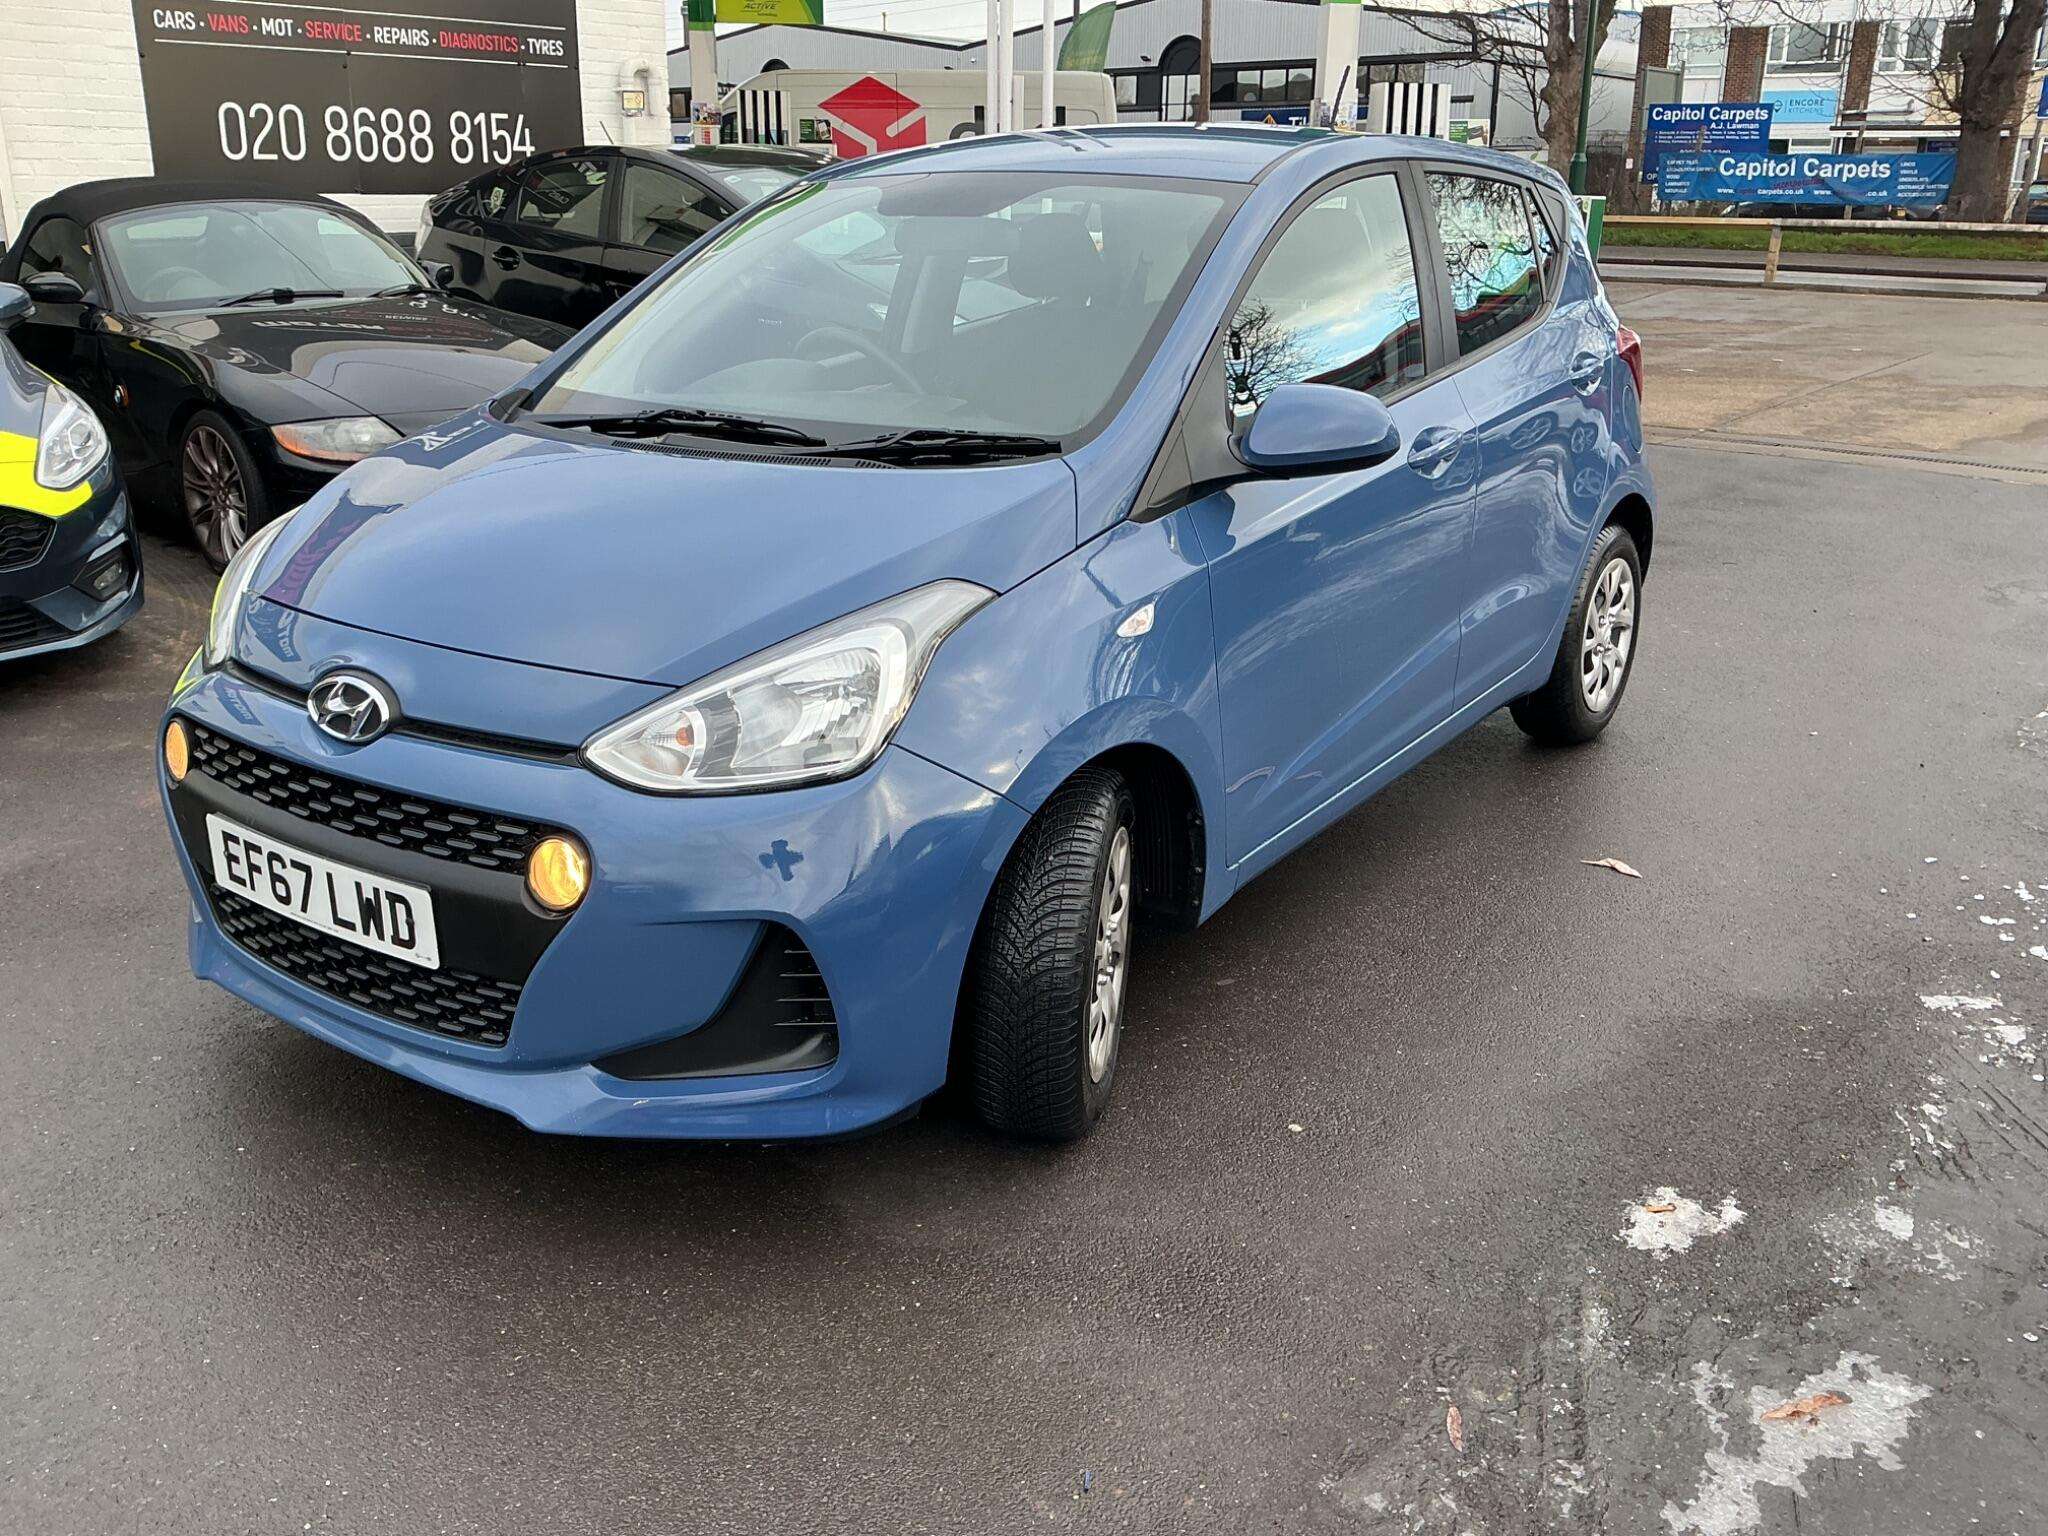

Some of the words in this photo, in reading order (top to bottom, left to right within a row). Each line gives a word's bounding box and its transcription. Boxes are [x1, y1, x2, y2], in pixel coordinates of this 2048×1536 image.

[743, 2, 777, 10] ACTIVE
[153, 9, 196, 31] CARS
[207, 13, 249, 34] VANS
[261, 17, 293, 37] MOT
[304, 20, 362, 42] SERVICE
[374, 26, 430, 47] REPAIRS
[439, 31, 518, 53] DIAGNOSTICS
[527, 38, 564, 56] TYRES
[1652, 107, 1705, 123] Capitol
[1709, 106, 1769, 122] Carpets
[1790, 99, 1825, 107] ENCORE
[218, 101, 307, 161] 020
[324, 105, 434, 163] 8688
[450, 110, 536, 165] 8154
[1719, 157, 1797, 180] Capitol
[1803, 158, 1892, 182] Carpets
[221, 830, 313, 914] EF67
[325, 871, 416, 950] LWD
